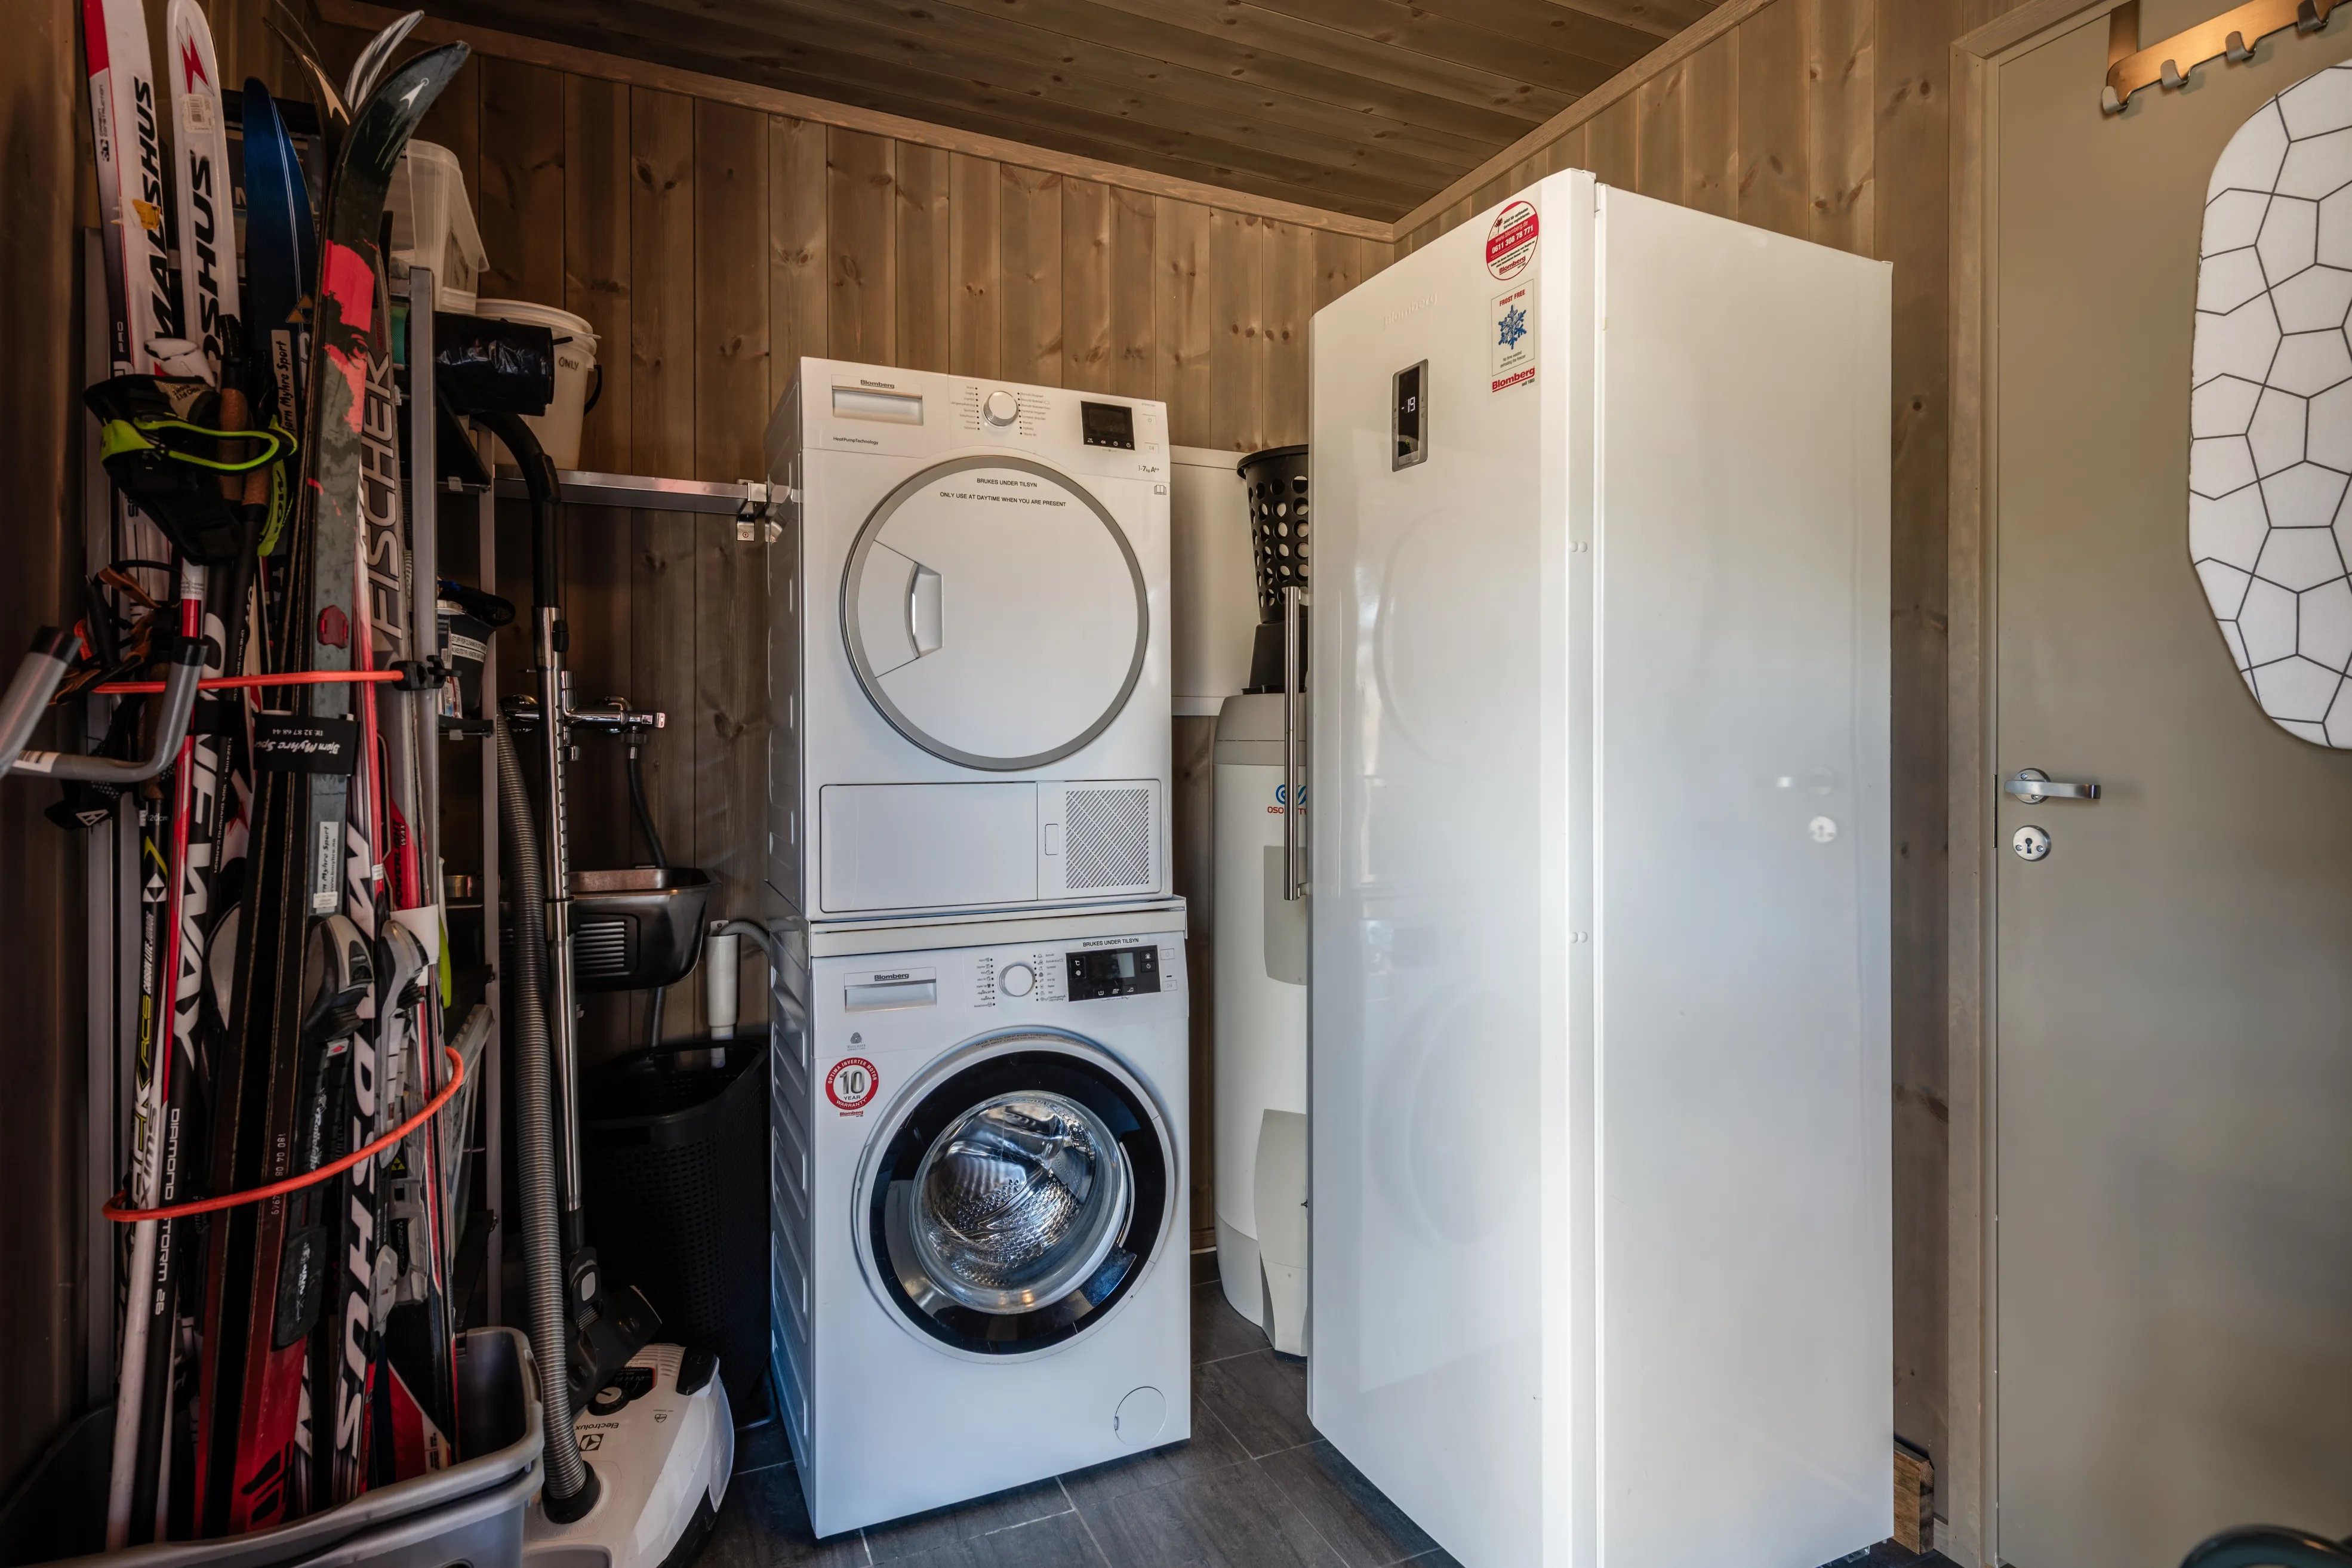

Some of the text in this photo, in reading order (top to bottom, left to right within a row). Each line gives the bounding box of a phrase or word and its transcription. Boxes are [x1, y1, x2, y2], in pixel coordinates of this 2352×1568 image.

[1492, 242, 1504, 254] 0611
[1505, 235, 1515, 246] 308
[1516, 232, 1523, 241] 78
[1523, 224, 1534, 236] 771
[1495, 221, 1528, 243] www.blomberg.de
[1499, 255, 1526, 273] Blomberg
[1500, 289, 1525, 307] FROST FREE
[1383, 292, 1437, 329] Blomberg
[117, 321, 125, 353] PRO
[276, 340, 291, 371] Sport
[559, 356, 579, 371] ONLY
[860, 380, 895, 389] Blomberg
[1492, 366, 1535, 390] Blomberg
[282, 409, 296, 432] jørn
[277, 739, 318, 754] Myhre
[317, 740, 341, 756] Bjørn
[217, 802, 226, 839] DIAMOND
[322, 825, 330, 851] Sport
[213, 839, 222, 874] CARBON
[321, 854, 330, 882] Myhre
[392, 817, 403, 908] POWERLIGHT
[141, 911, 156, 995] CARBON LITE JUNIOR
[874, 972, 909, 982] Blomberg
[828, 1059, 878, 1084] OPTIMA INVERTER MOTOR
[839, 1070, 865, 1095] 10
[276, 1133, 287, 1148] 180
[275, 1152, 285, 1163] 04
[275, 1166, 284, 1177] 08
[155, 1108, 180, 1316] DIAMOND TORM 26
[575, 1422, 620, 1431] Electrolux
